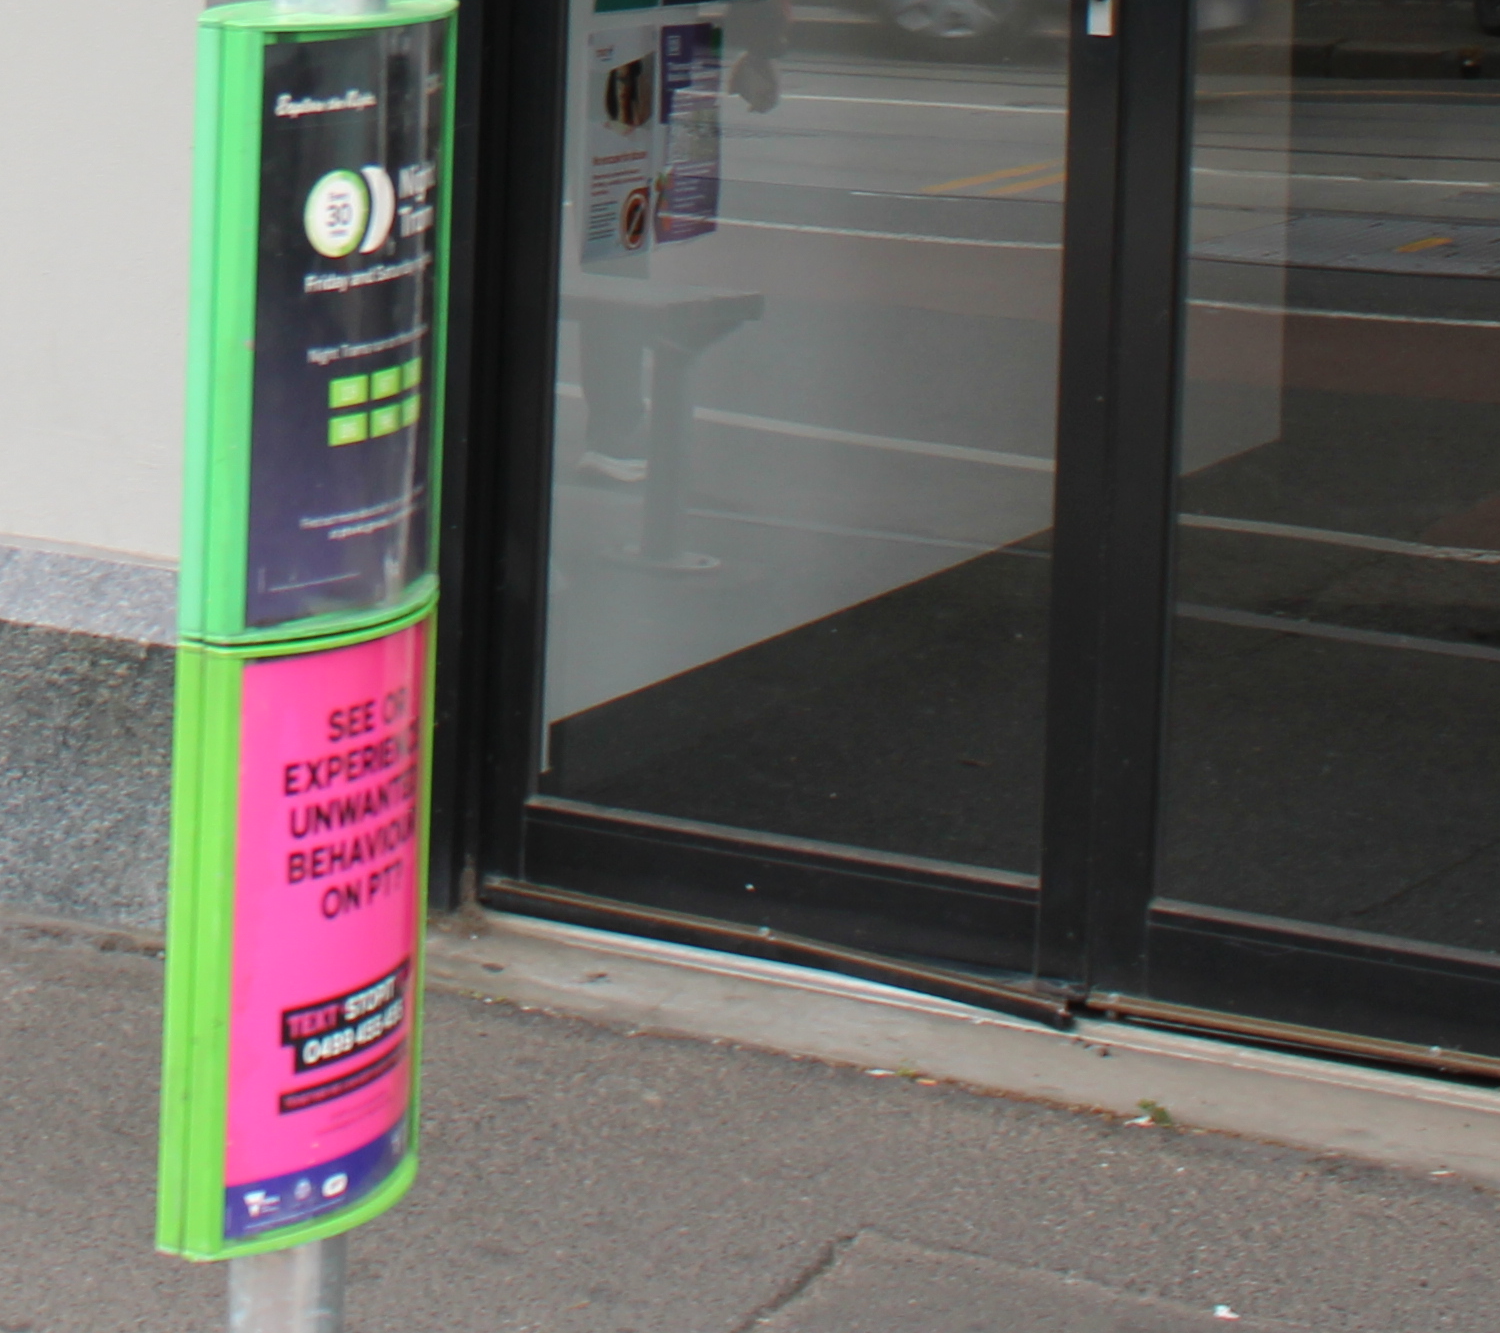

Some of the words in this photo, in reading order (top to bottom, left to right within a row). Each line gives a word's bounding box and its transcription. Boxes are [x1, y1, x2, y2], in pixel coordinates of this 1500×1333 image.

[328, 699, 376, 744] SEE
[321, 875, 362, 921] ON
[286, 1003, 339, 1040] TEXT
